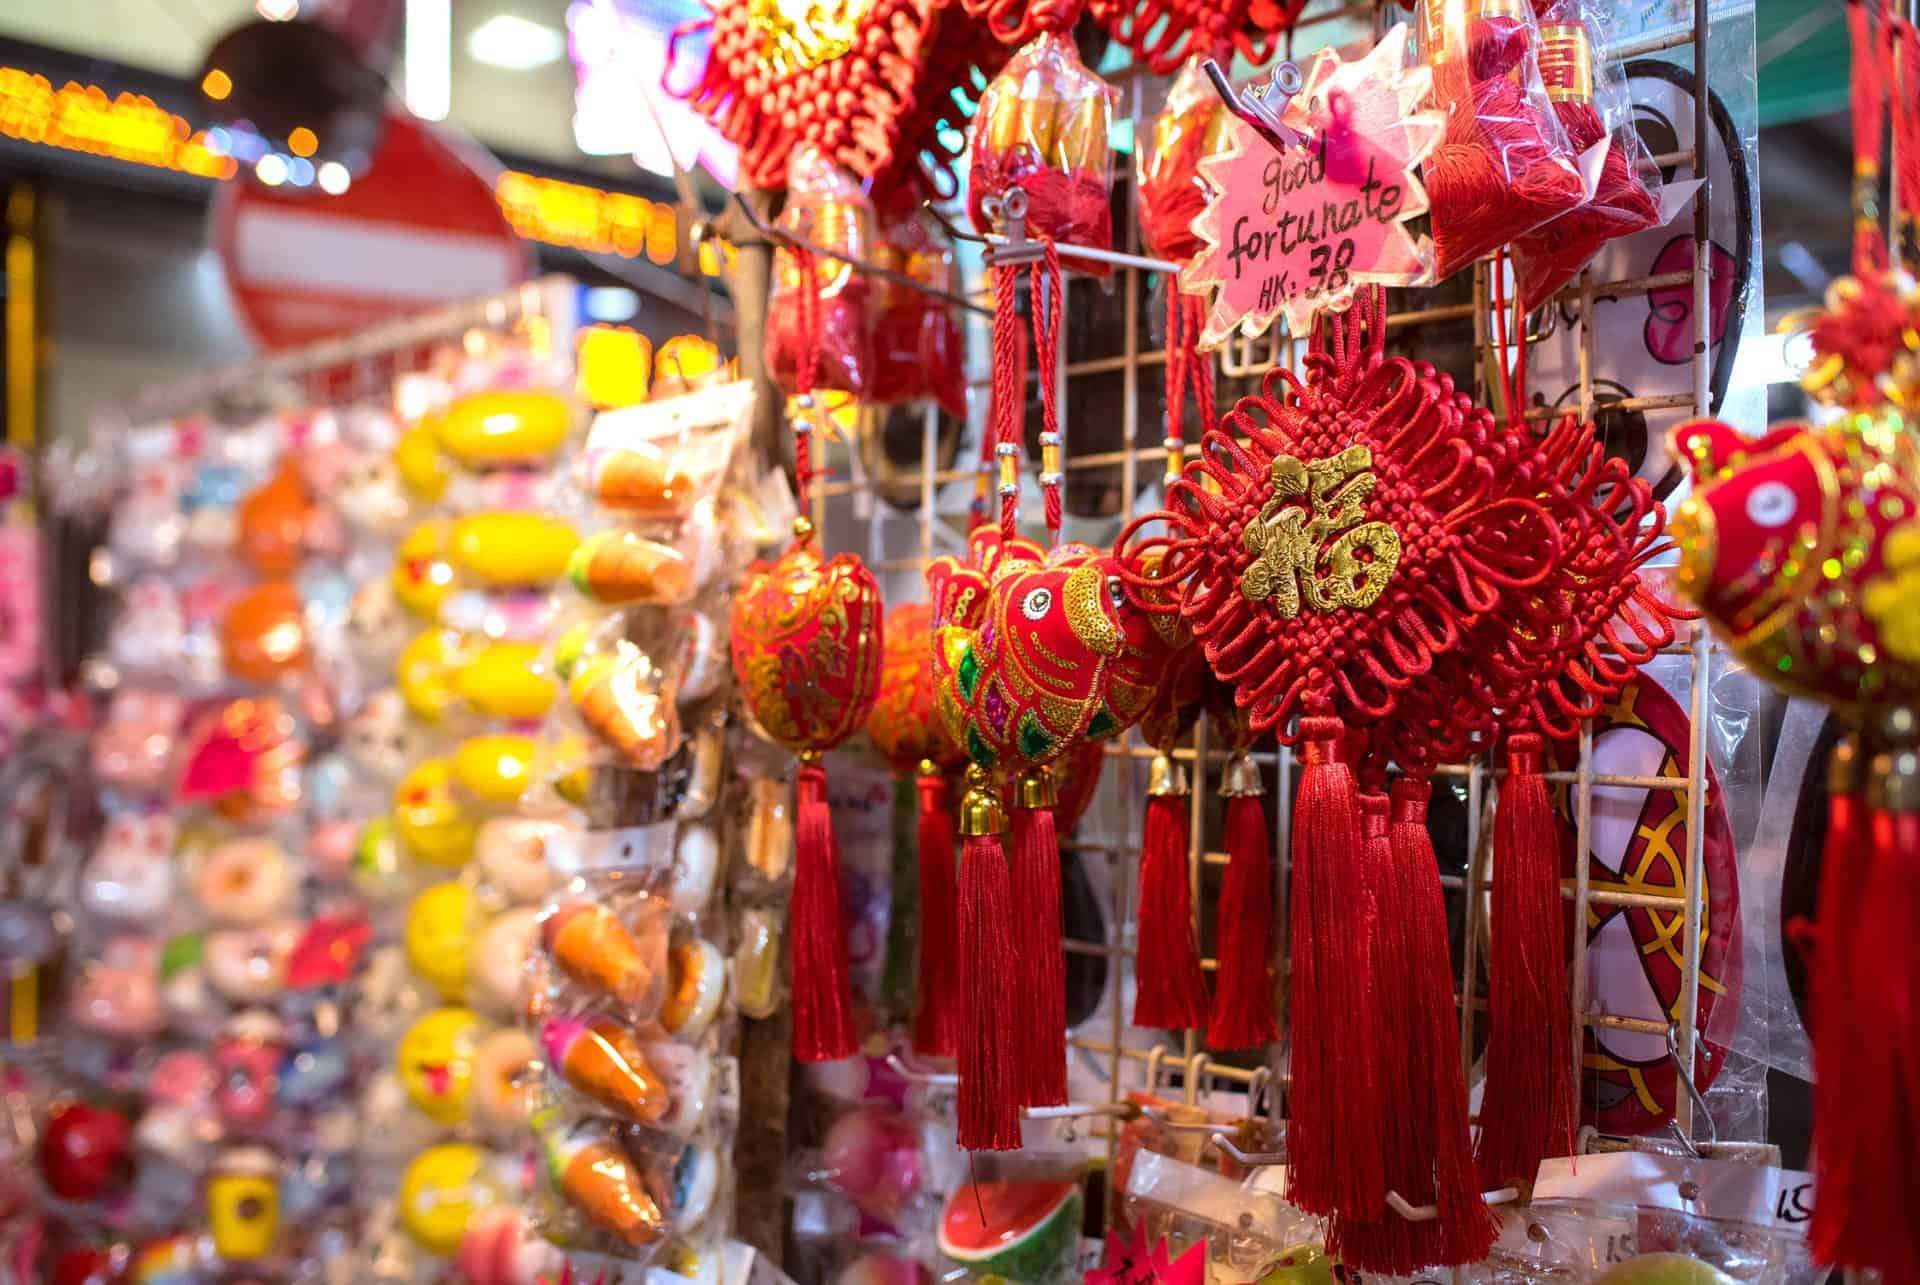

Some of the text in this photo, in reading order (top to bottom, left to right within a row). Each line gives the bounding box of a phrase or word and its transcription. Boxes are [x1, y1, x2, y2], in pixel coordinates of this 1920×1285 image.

[1227, 156, 1401, 280] fortunate
[1262, 128, 1327, 215] good
[1304, 238, 1356, 300] 38
[1241, 445, 1400, 619] 福
